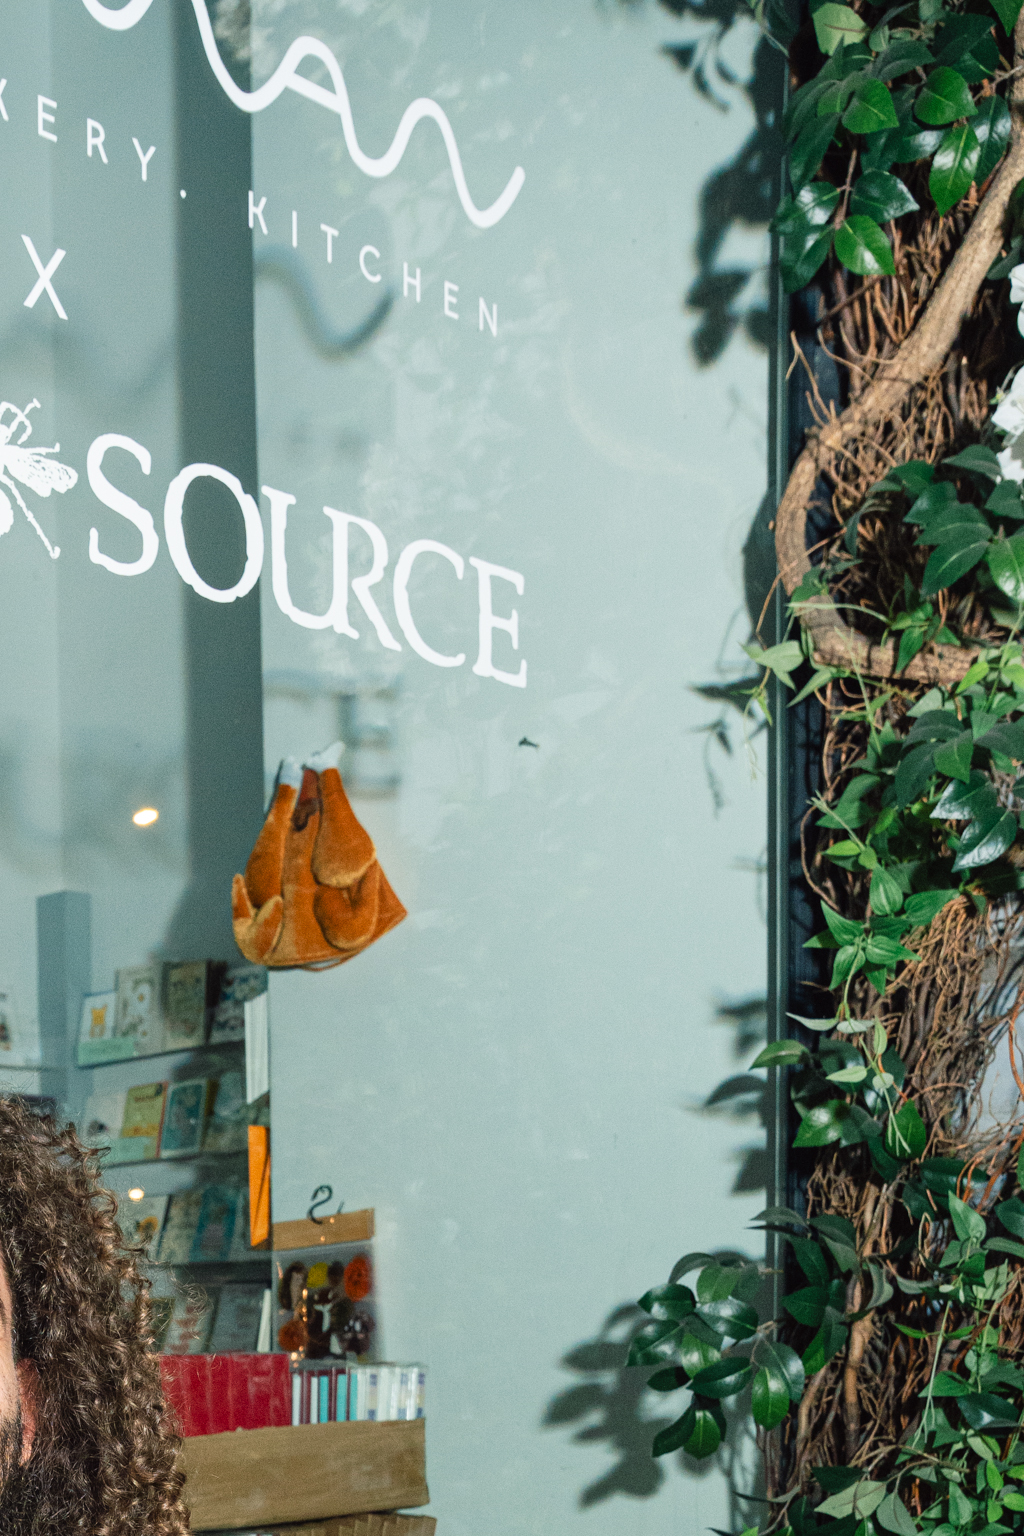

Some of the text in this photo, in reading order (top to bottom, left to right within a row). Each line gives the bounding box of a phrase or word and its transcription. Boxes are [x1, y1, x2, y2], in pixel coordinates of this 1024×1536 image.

[20, 233, 69, 321] X
[247, 190, 499, 338] KITCHEN
[85, 433, 529, 689] SOURCE
